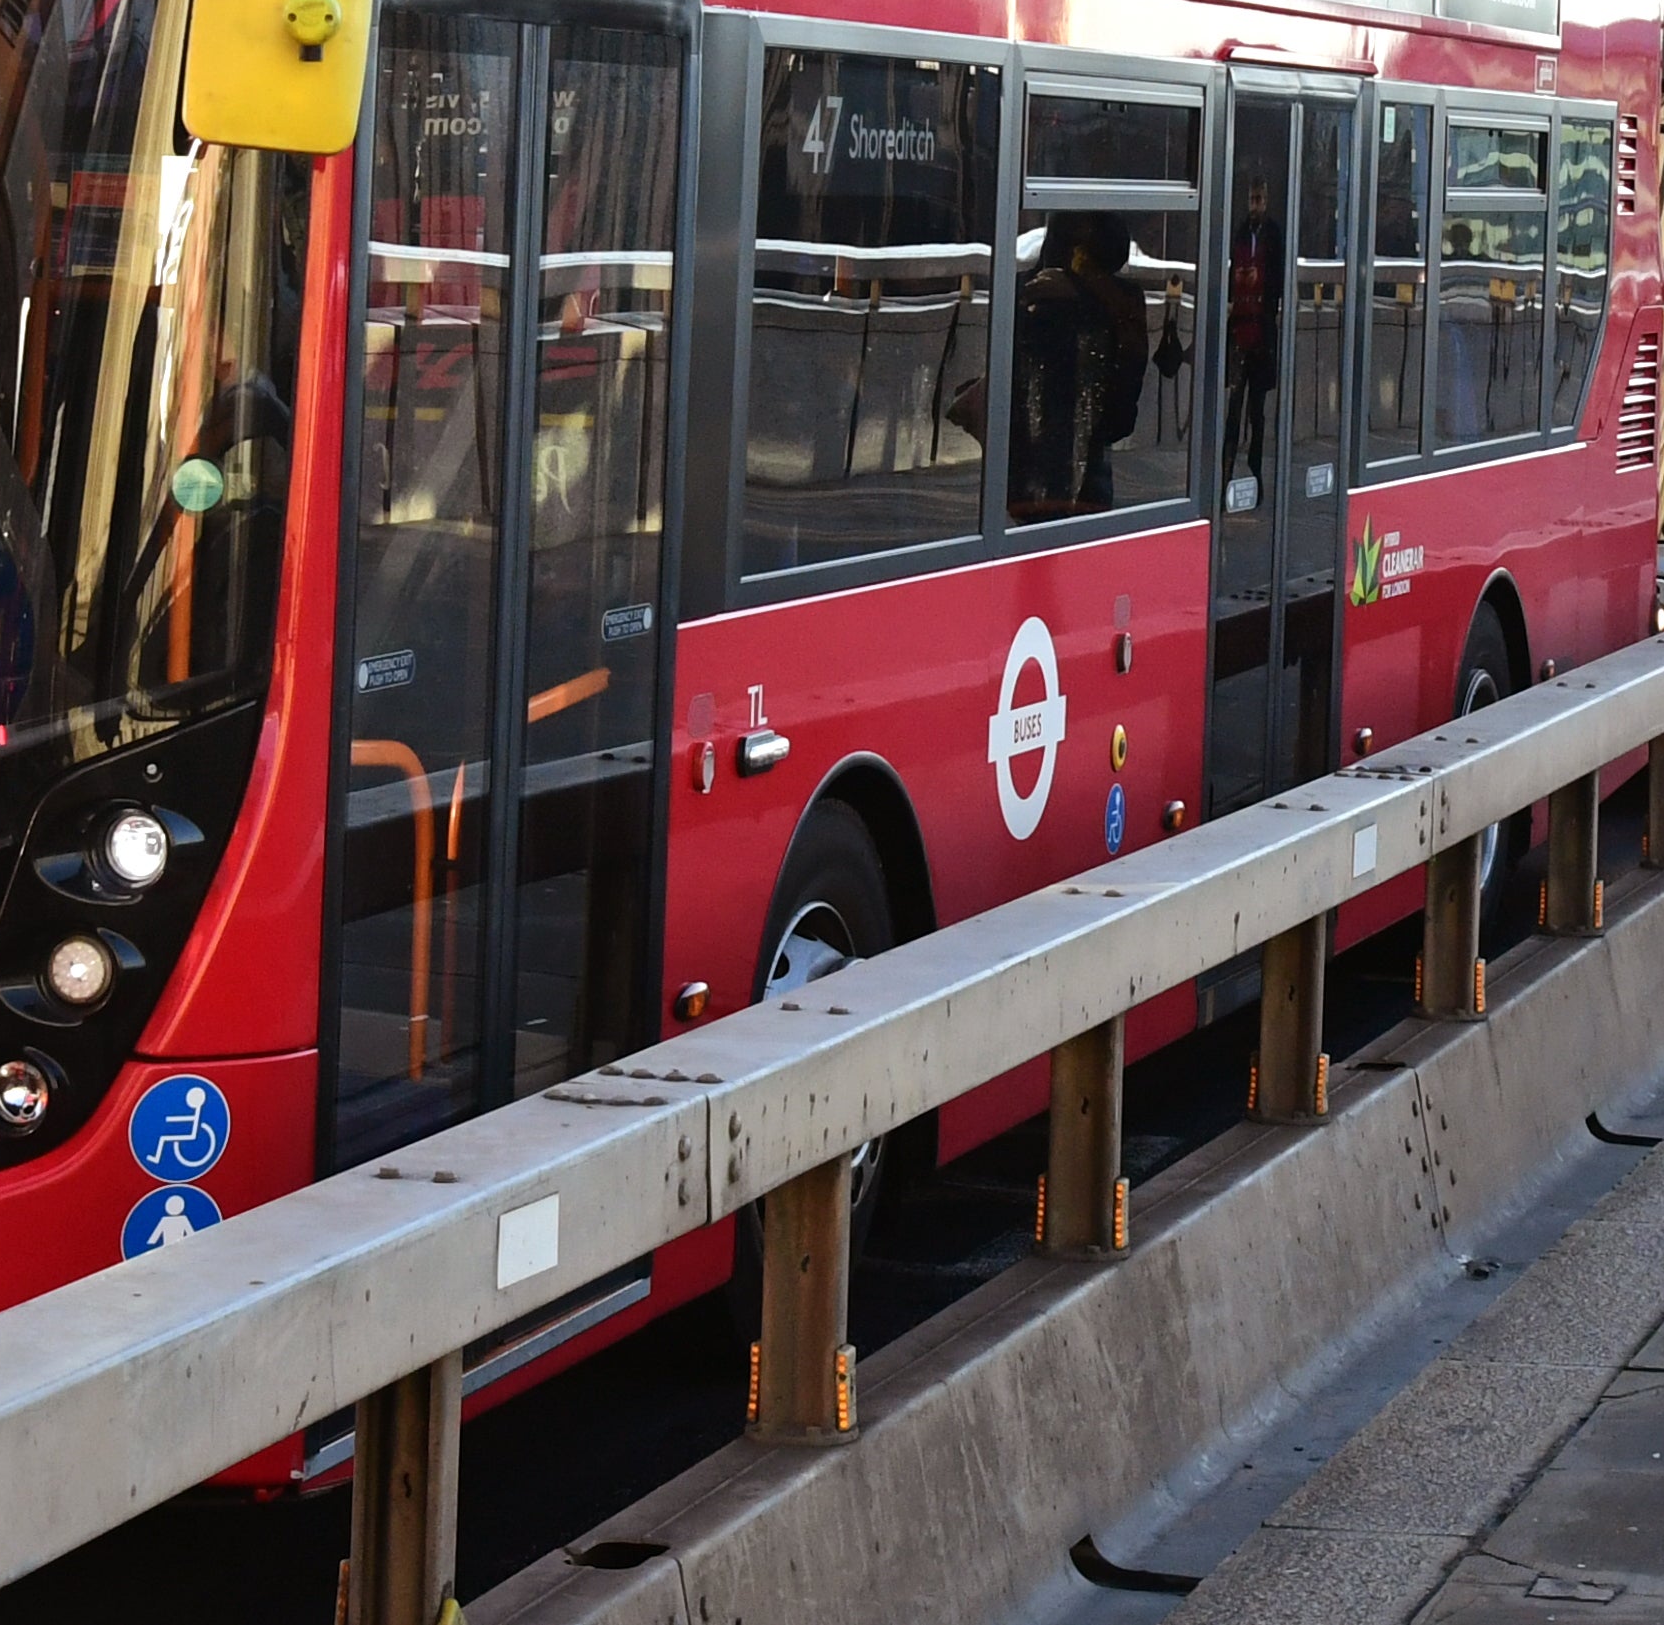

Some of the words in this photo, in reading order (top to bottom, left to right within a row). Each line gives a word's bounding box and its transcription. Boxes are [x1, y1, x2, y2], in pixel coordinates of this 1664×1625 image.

[802, 95, 844, 174] 47
[848, 113, 935, 161] Shoreditch
[748, 684, 768, 728] TL
[1014, 712, 1042, 744] BUSES
